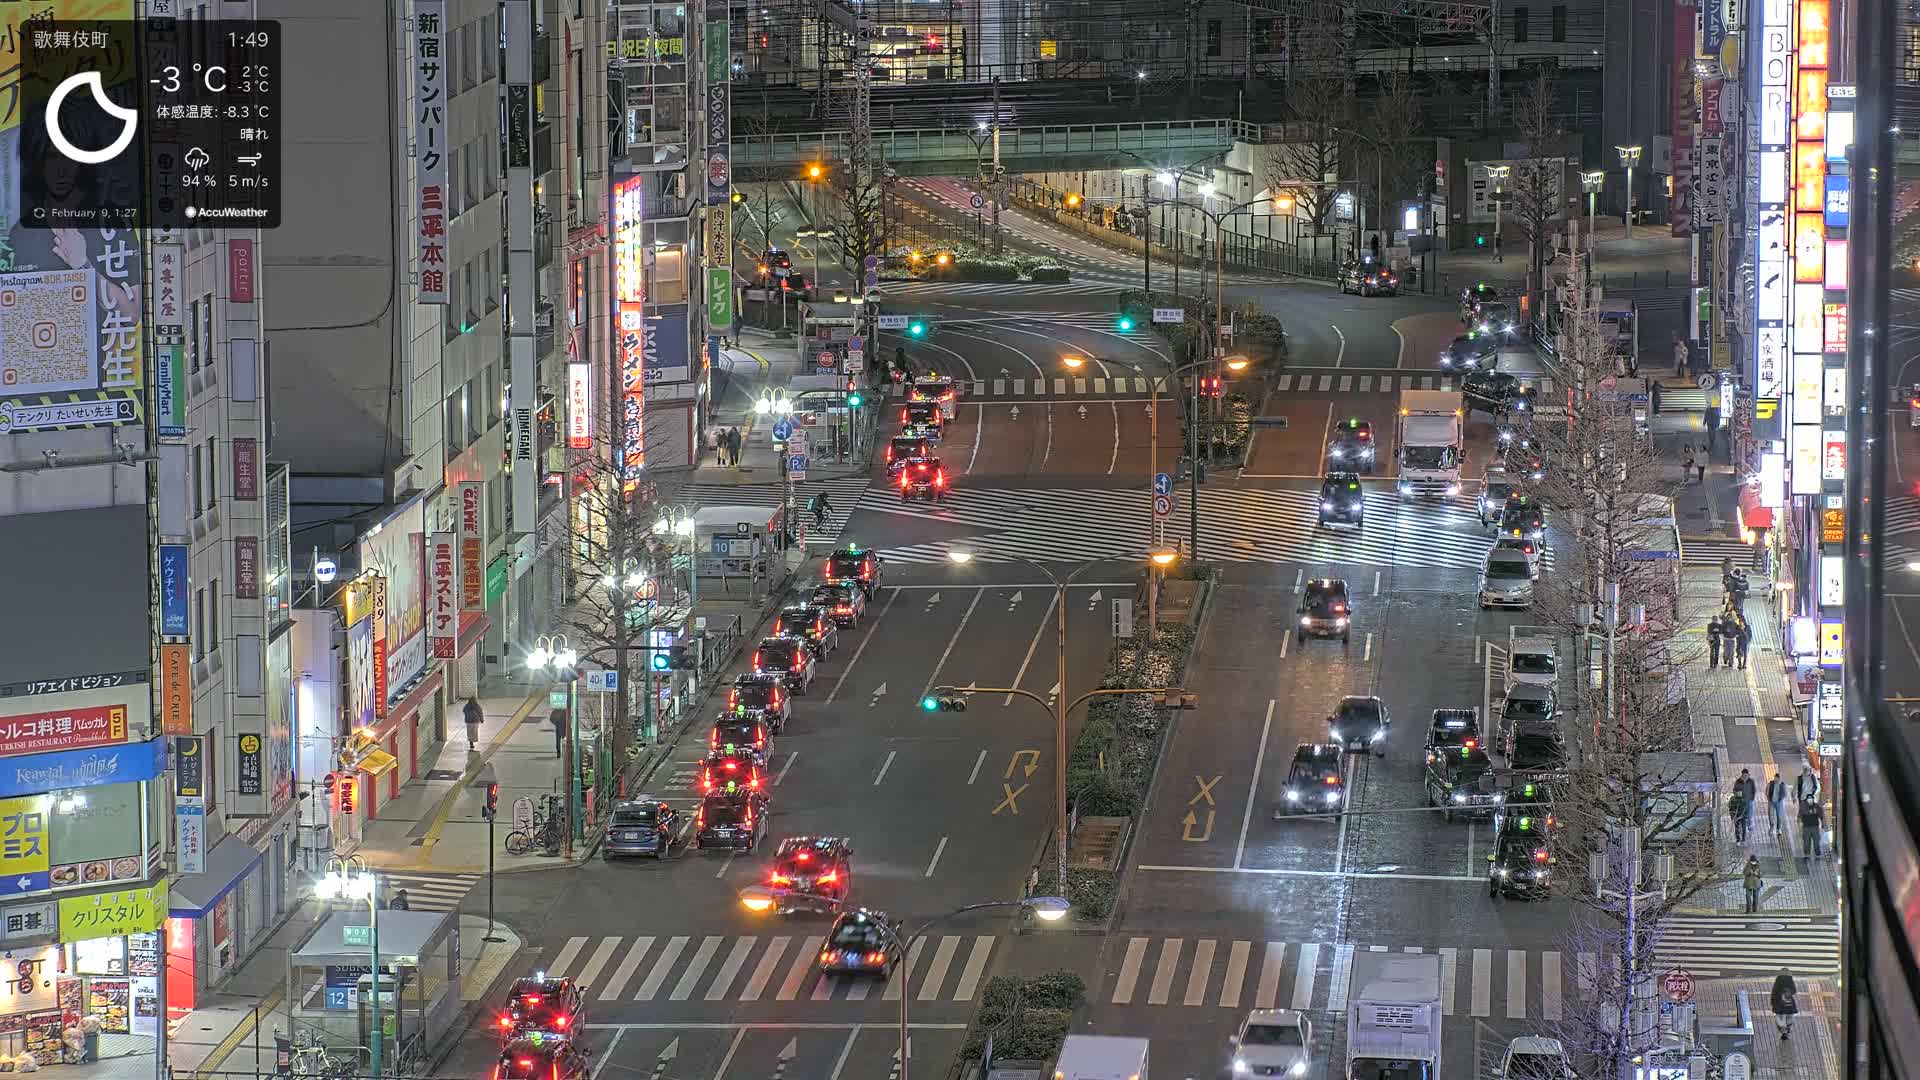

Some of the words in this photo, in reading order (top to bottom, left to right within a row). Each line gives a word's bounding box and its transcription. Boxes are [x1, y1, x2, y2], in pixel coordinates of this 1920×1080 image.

[418, 13, 441, 171] 新宿サンパーク
[1707, 90, 1719, 121] アコム
[421, 185, 444, 293] 三平本館
[0, 275, 43, 289] Instagram
[713, 277, 725, 315] レイク
[623, 333, 640, 388] ラーメン
[160, 355, 172, 416] FamilyMart
[17, 411, 52, 423] テンクリ
[57, 407, 114, 420] たいせい先生
[518, 408, 530, 461] HOMEGAME
[463, 488, 475, 532] GAME
[716, 542, 728, 552] 10
[435, 544, 452, 630] 三平ストア
[376, 583, 384, 620] 389
[171, 651, 181, 674] CAFE
[27, 678, 80, 695] リアエイド
[82, 675, 122, 689] ビジョン
[171, 695, 181, 720] CRIE
[113, 712, 122, 736] 5F
[28, 735, 73, 748] RESTAURANT
[244, 737, 257, 752] 占
[183, 807, 194, 815] 2F
[3, 812, 43, 837] プロ
[3, 837, 43, 860] ミス
[182, 819, 190, 859] ゲウチャイ
[8, 912, 42, 933] 囲碁
[73, 904, 144, 928] クリスタル
[329, 992, 345, 1005] 12
